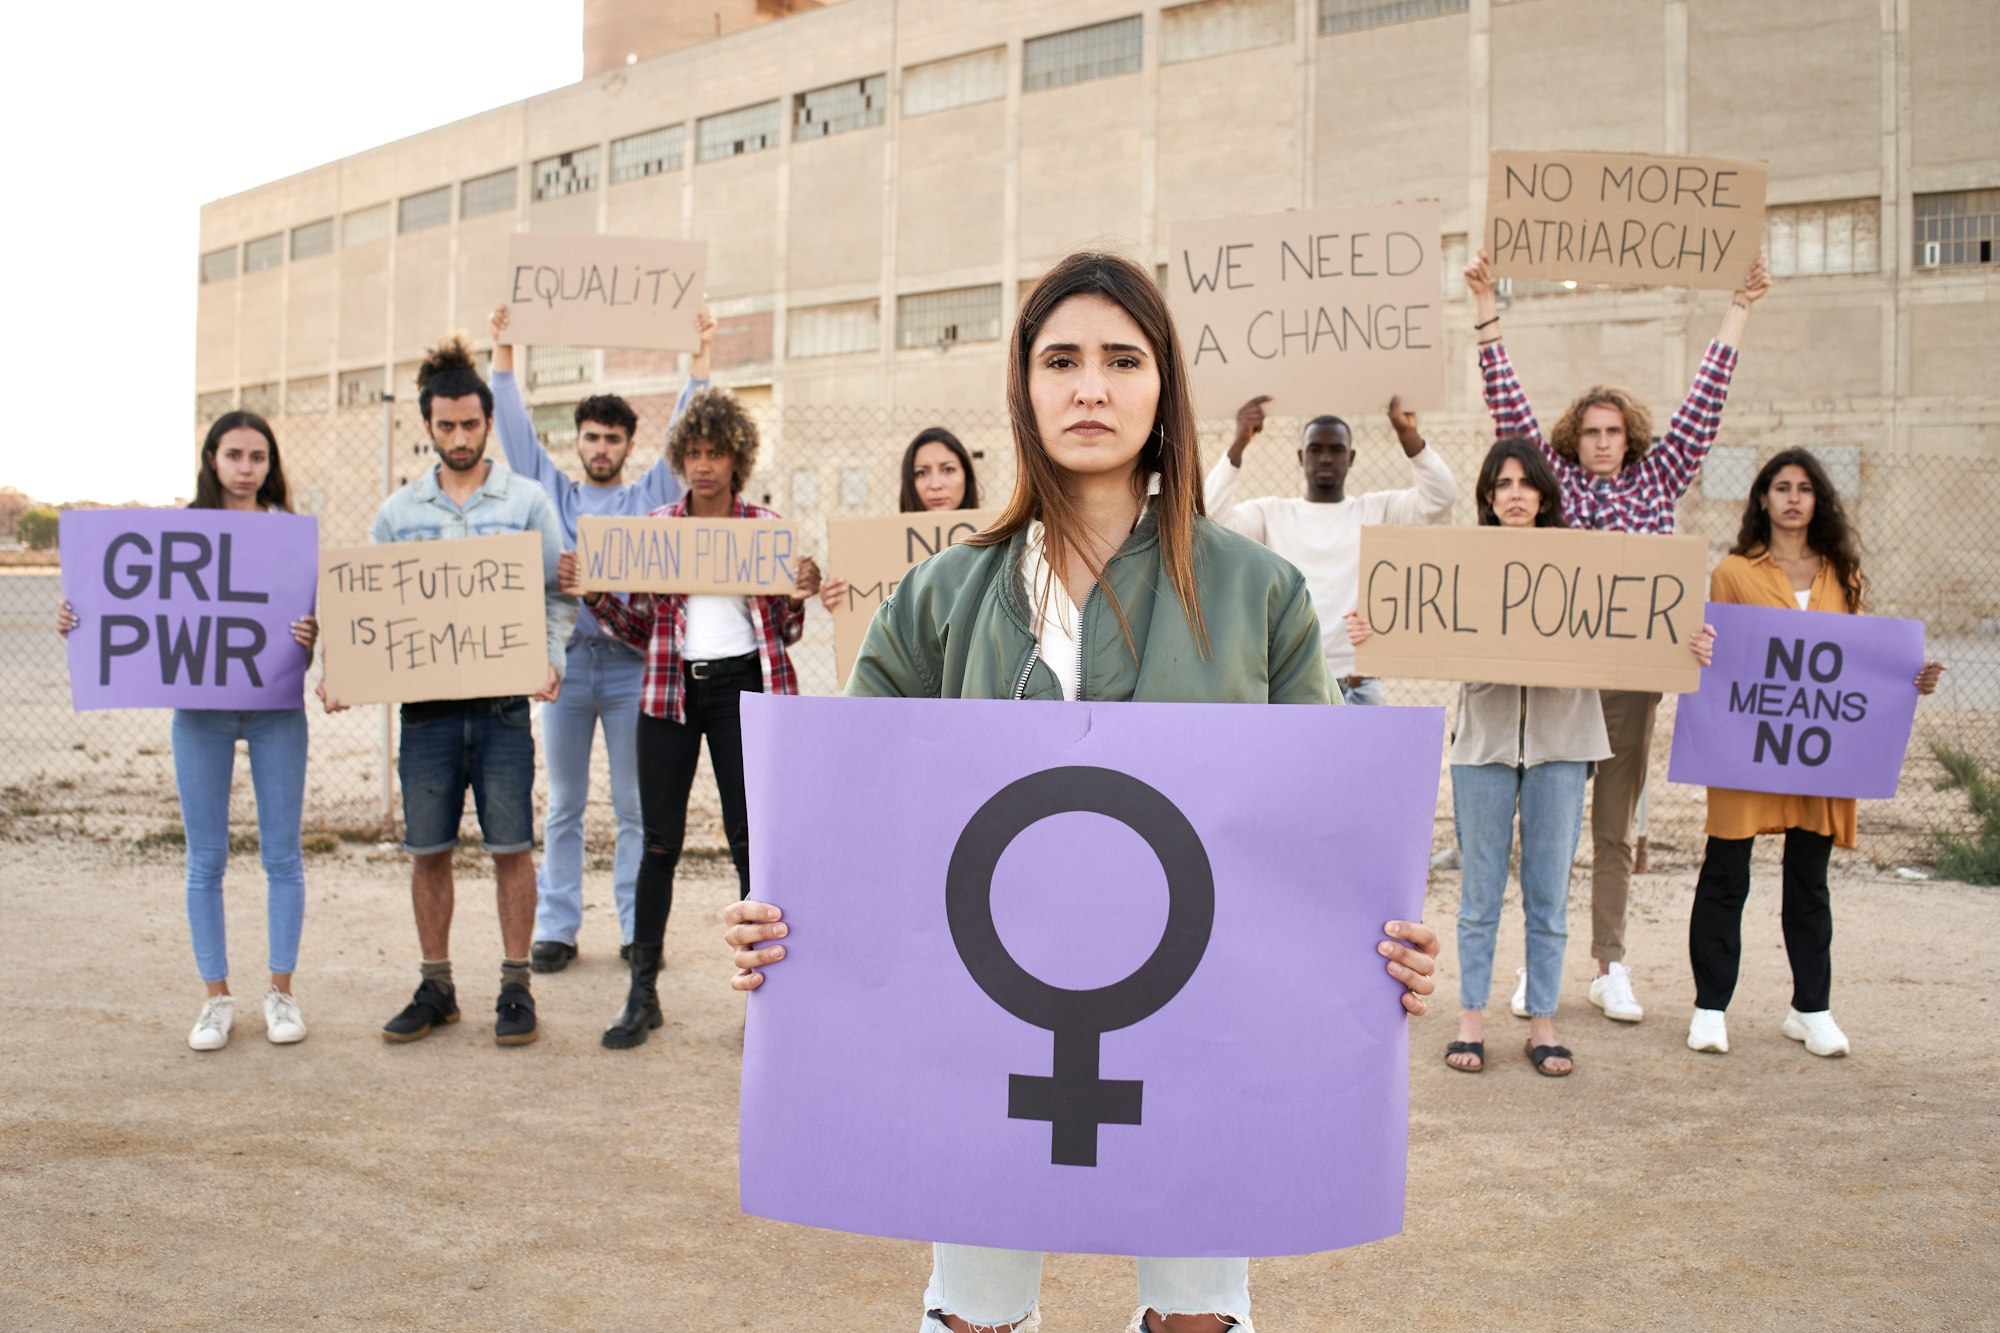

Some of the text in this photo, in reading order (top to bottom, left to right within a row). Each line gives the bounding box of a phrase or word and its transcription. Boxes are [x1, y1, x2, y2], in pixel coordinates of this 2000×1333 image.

[1506, 163, 1741, 208] NO MORE
[1183, 231, 1424, 294] WE NEED
[1193, 303, 1433, 367] A CHANGE
[103, 531, 269, 604] GRL
[328, 558, 525, 605] THE FUTURE
[581, 527, 795, 586] WOMAN POWER
[1367, 559, 1685, 645] GIRL POWER
[99, 614, 268, 688] PWR
[351, 616, 530, 672] IS FEMALE
[1763, 636, 1844, 683] NO
[1728, 681, 1868, 723] MEANS
[1752, 720, 1833, 768] NO
